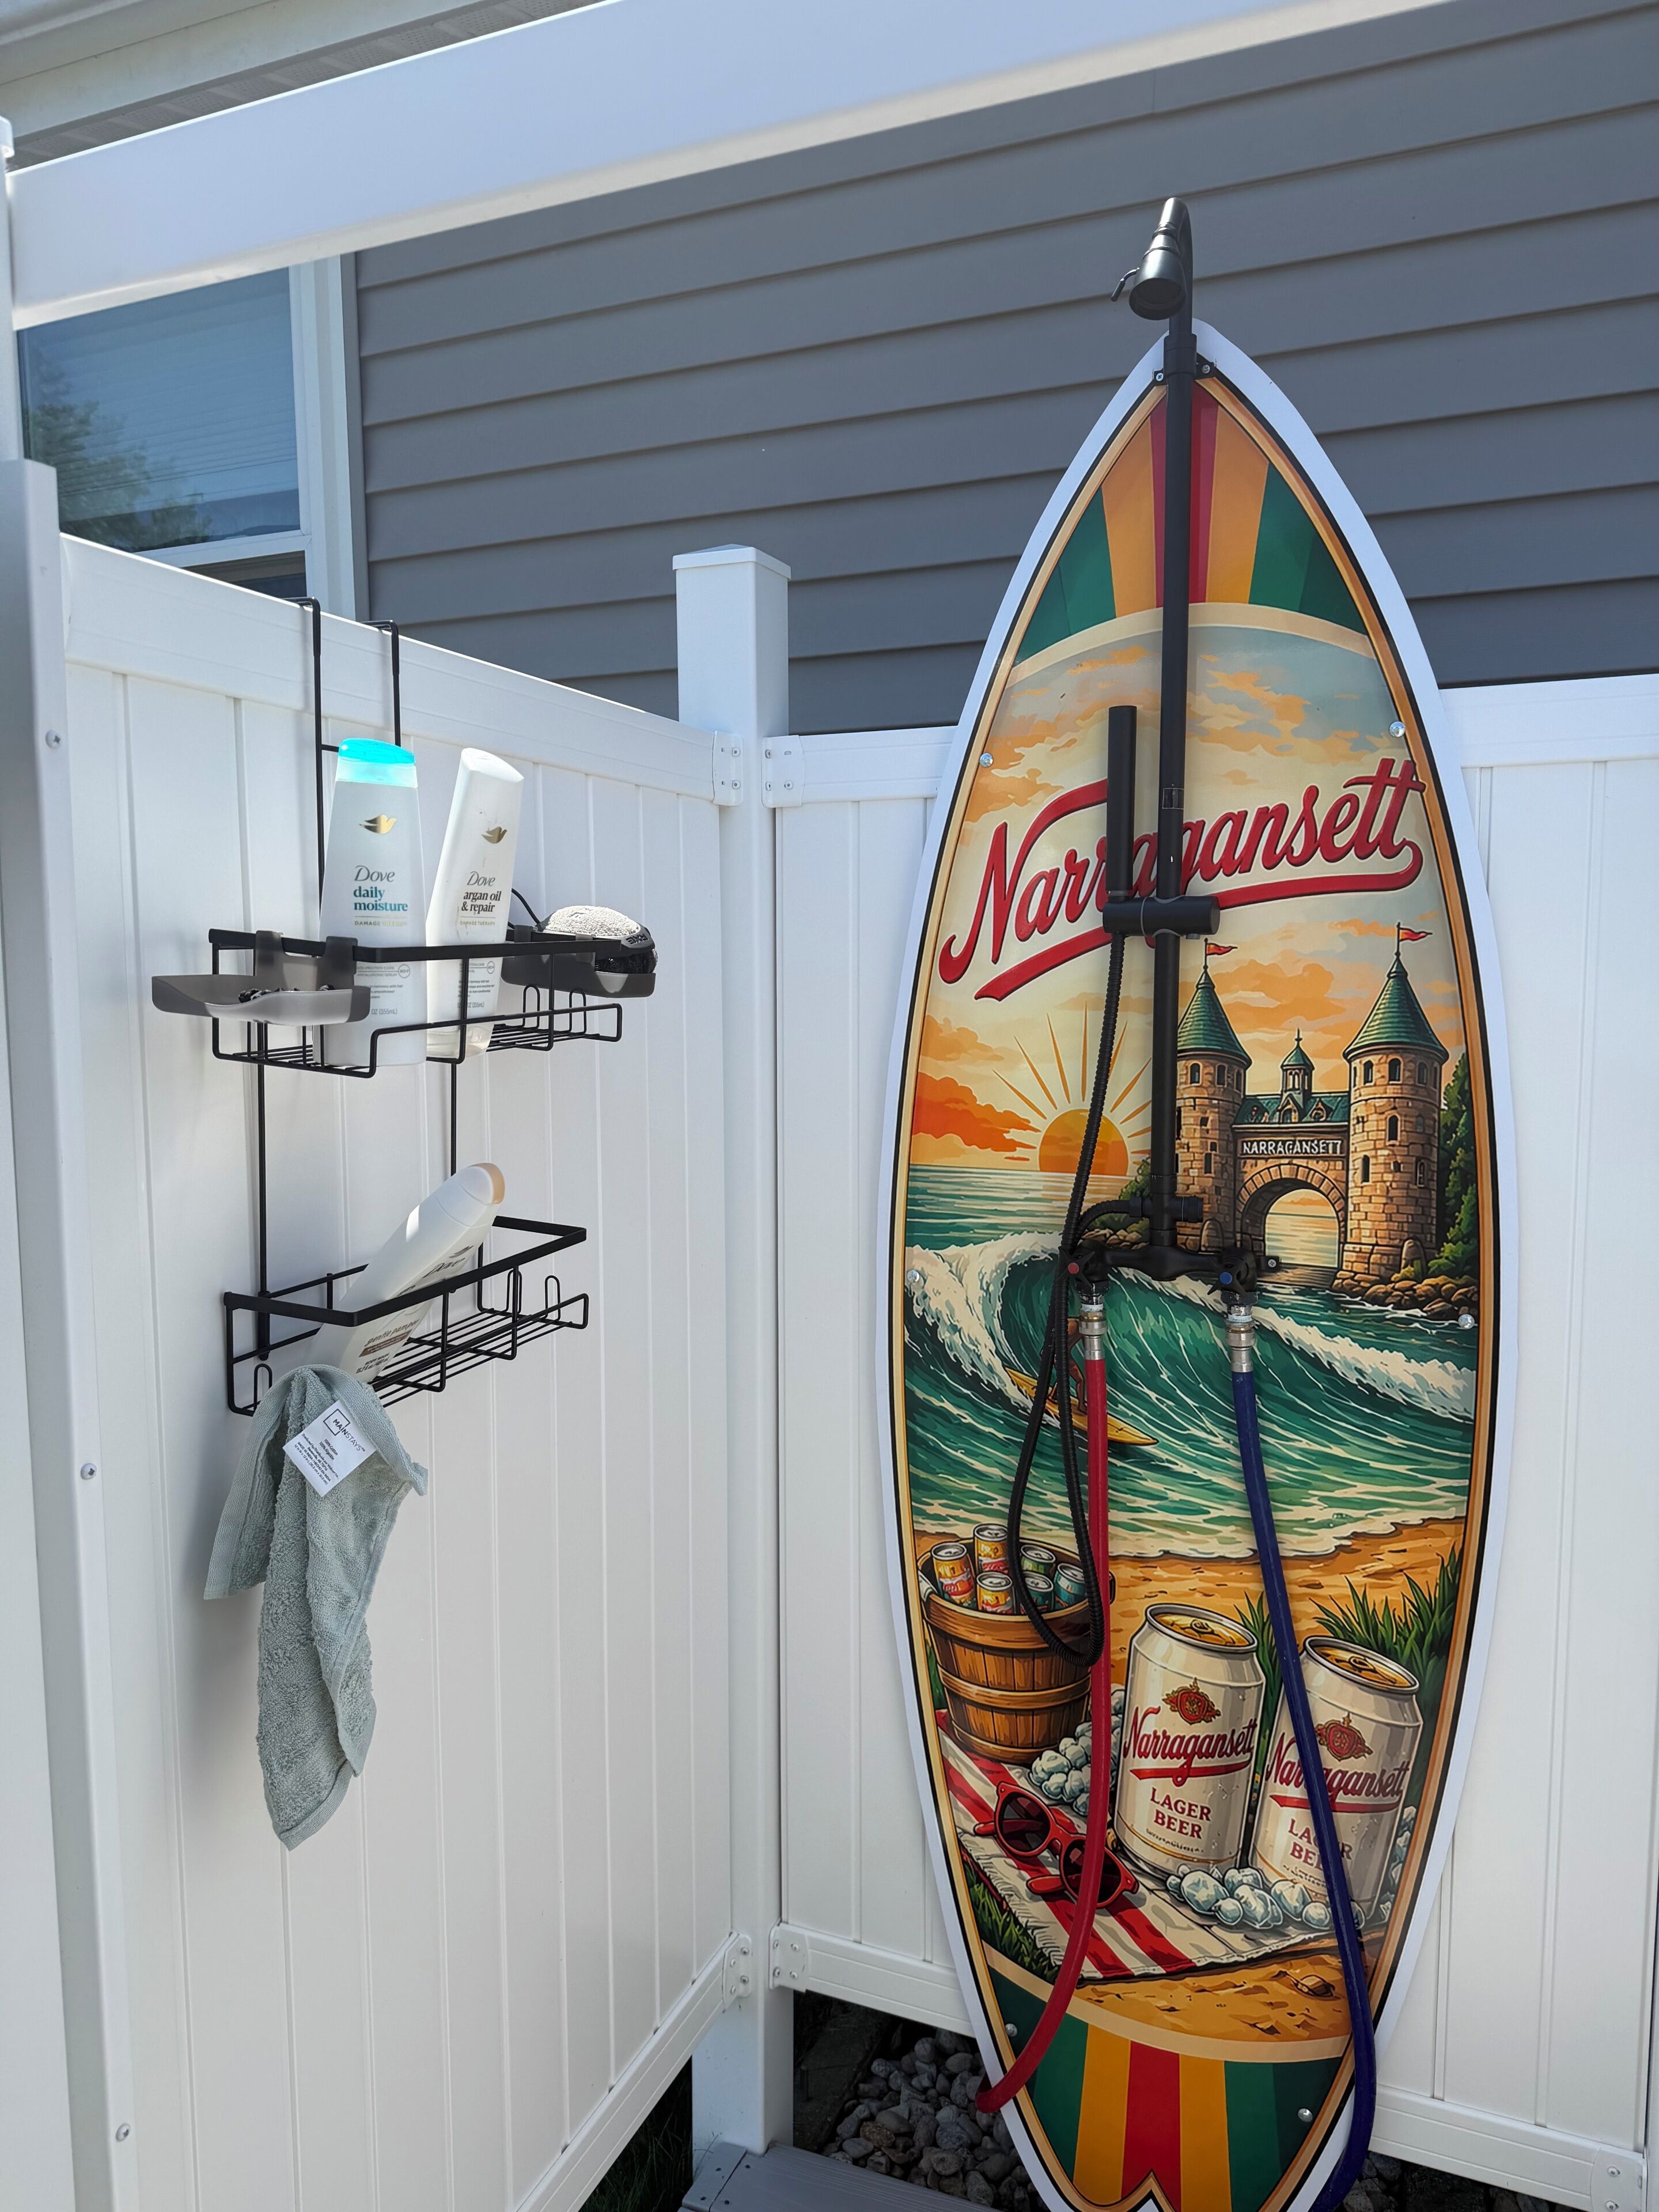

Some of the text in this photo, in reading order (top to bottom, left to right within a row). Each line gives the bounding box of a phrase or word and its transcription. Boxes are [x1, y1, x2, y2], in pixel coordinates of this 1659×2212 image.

[354, 865, 395, 882] Dove
[467, 871, 495, 887] Dove
[353, 886, 385, 901] daily
[463, 891, 502, 902] argan oil
[354, 900, 408, 911] moisture
[461, 901, 495, 914] & repair
[1243, 1140, 1342, 1154] NARRAGANSETT
[1123, 1706, 1257, 1787] Narragansett
[1265, 1732, 1410, 1813] Nargansett
[1150, 1787, 1211, 1821] LAGER
[1154, 1809, 1202, 1839] BEER
[1288, 1818, 1353, 1860] LAR
[1290, 1842, 1323, 1871] BE
